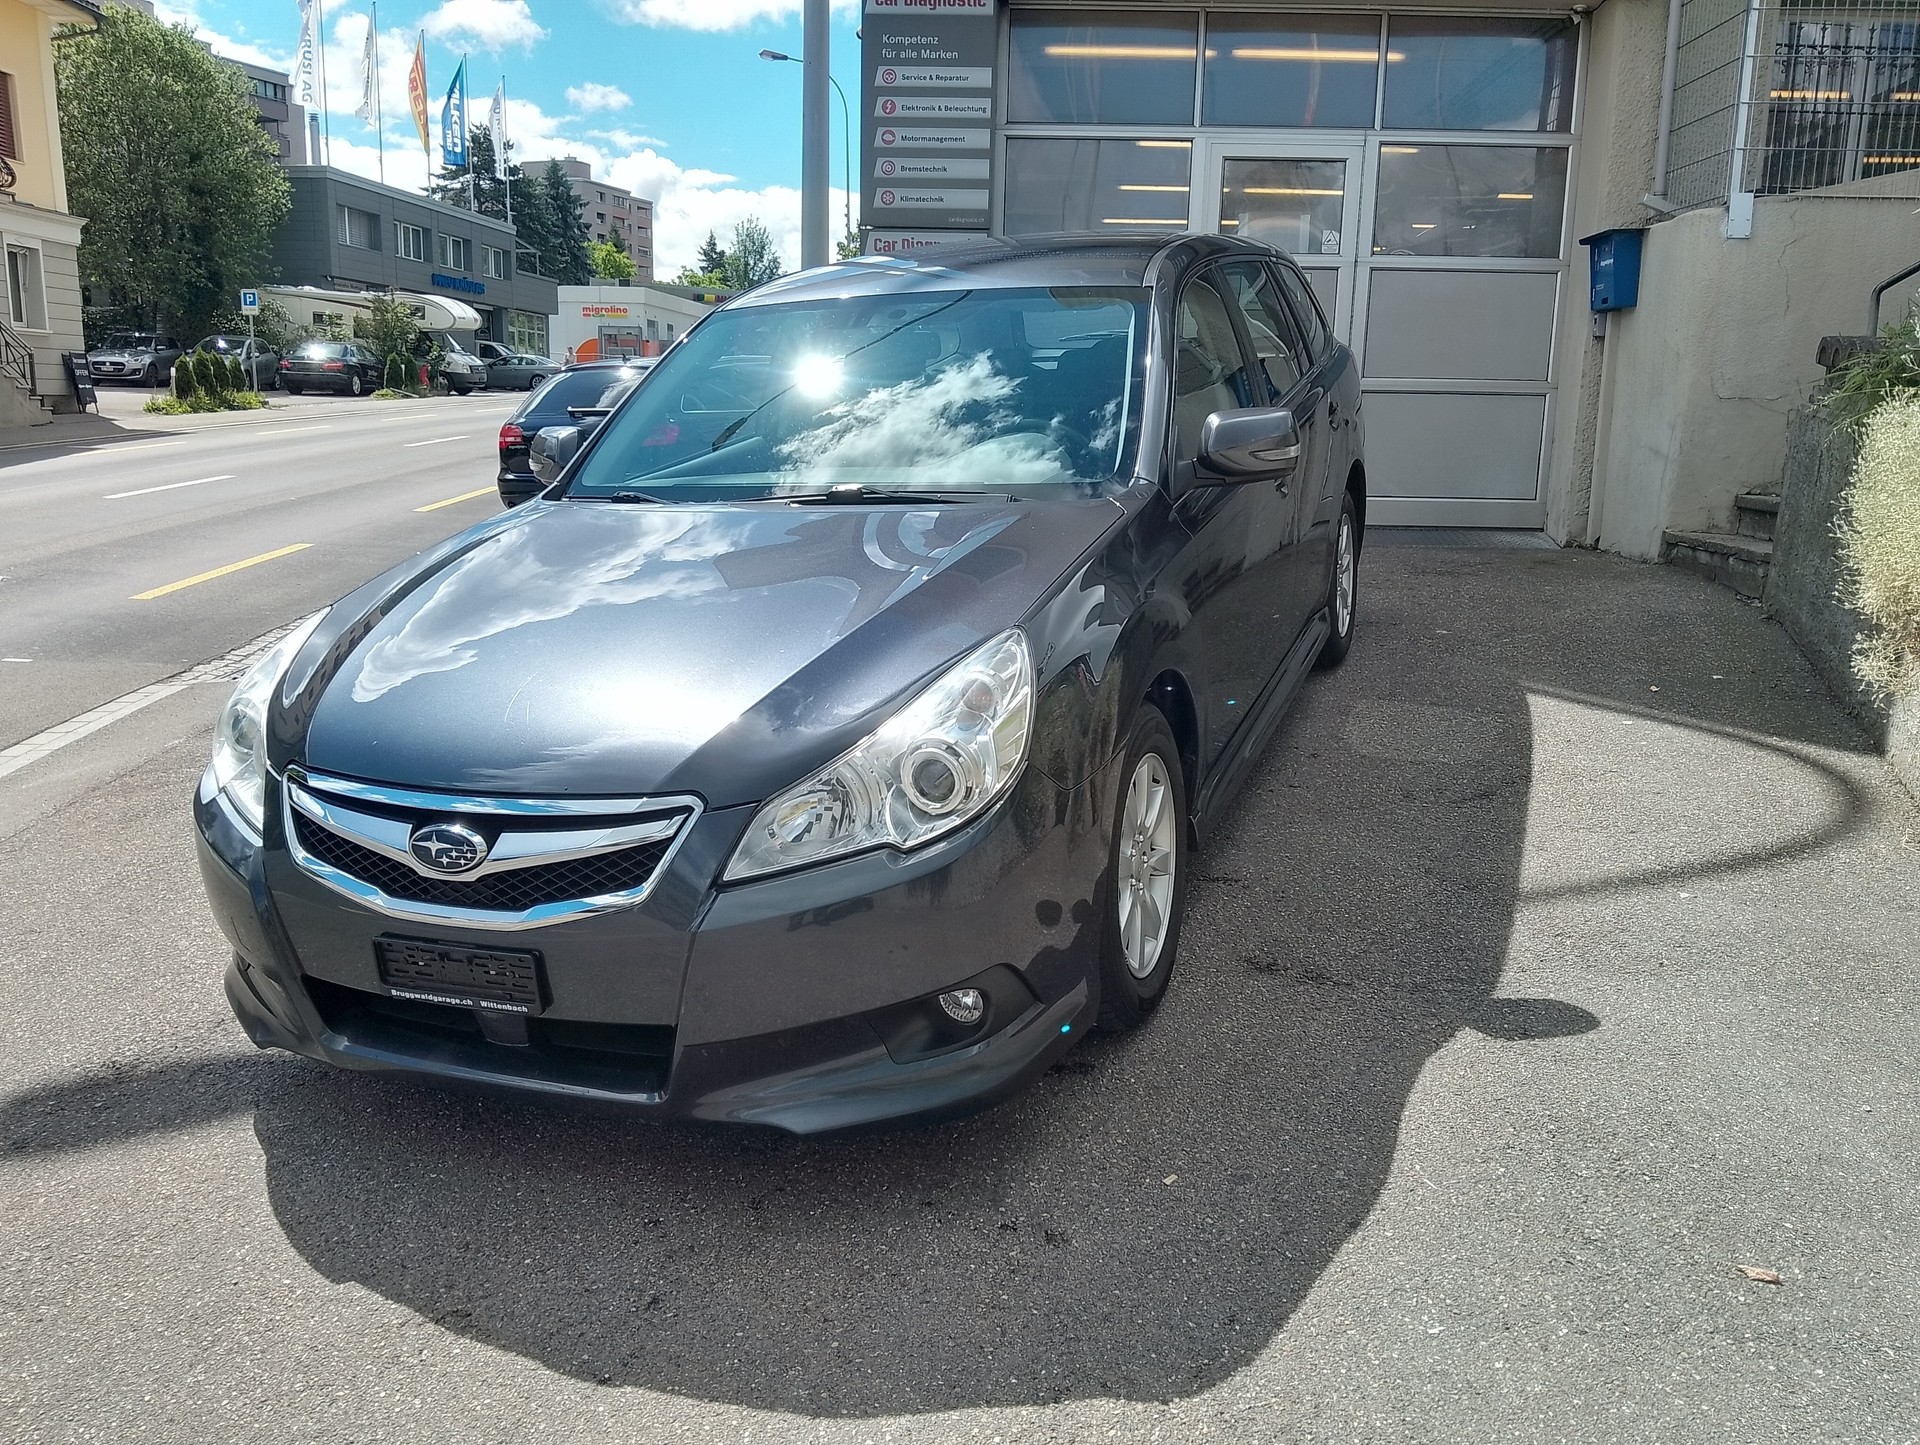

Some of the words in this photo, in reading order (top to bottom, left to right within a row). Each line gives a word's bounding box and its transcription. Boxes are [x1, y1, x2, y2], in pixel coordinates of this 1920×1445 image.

[882, 34, 939, 46] Kompetenz
[882, 49, 897, 58] für
[900, 49, 918, 59] alle
[921, 49, 959, 59] Marken
[901, 73, 927, 81] Service
[935, 74, 970, 82] Reparatur
[302, 79, 313, 103] AG
[901, 104, 936, 112] Elektronik
[944, 105, 987, 113] Beleuchtung
[901, 134, 966, 143] Motormanagement
[900, 165, 948, 173] Bremstechnik
[900, 195, 945, 203] Klimatechnik
[873, 238, 898, 252] Car
[582, 304, 628, 315] migrolino
[391, 989, 473, 1006] Bruggwaldgarage.ch
[479, 1000, 528, 1013] Wittenbach
